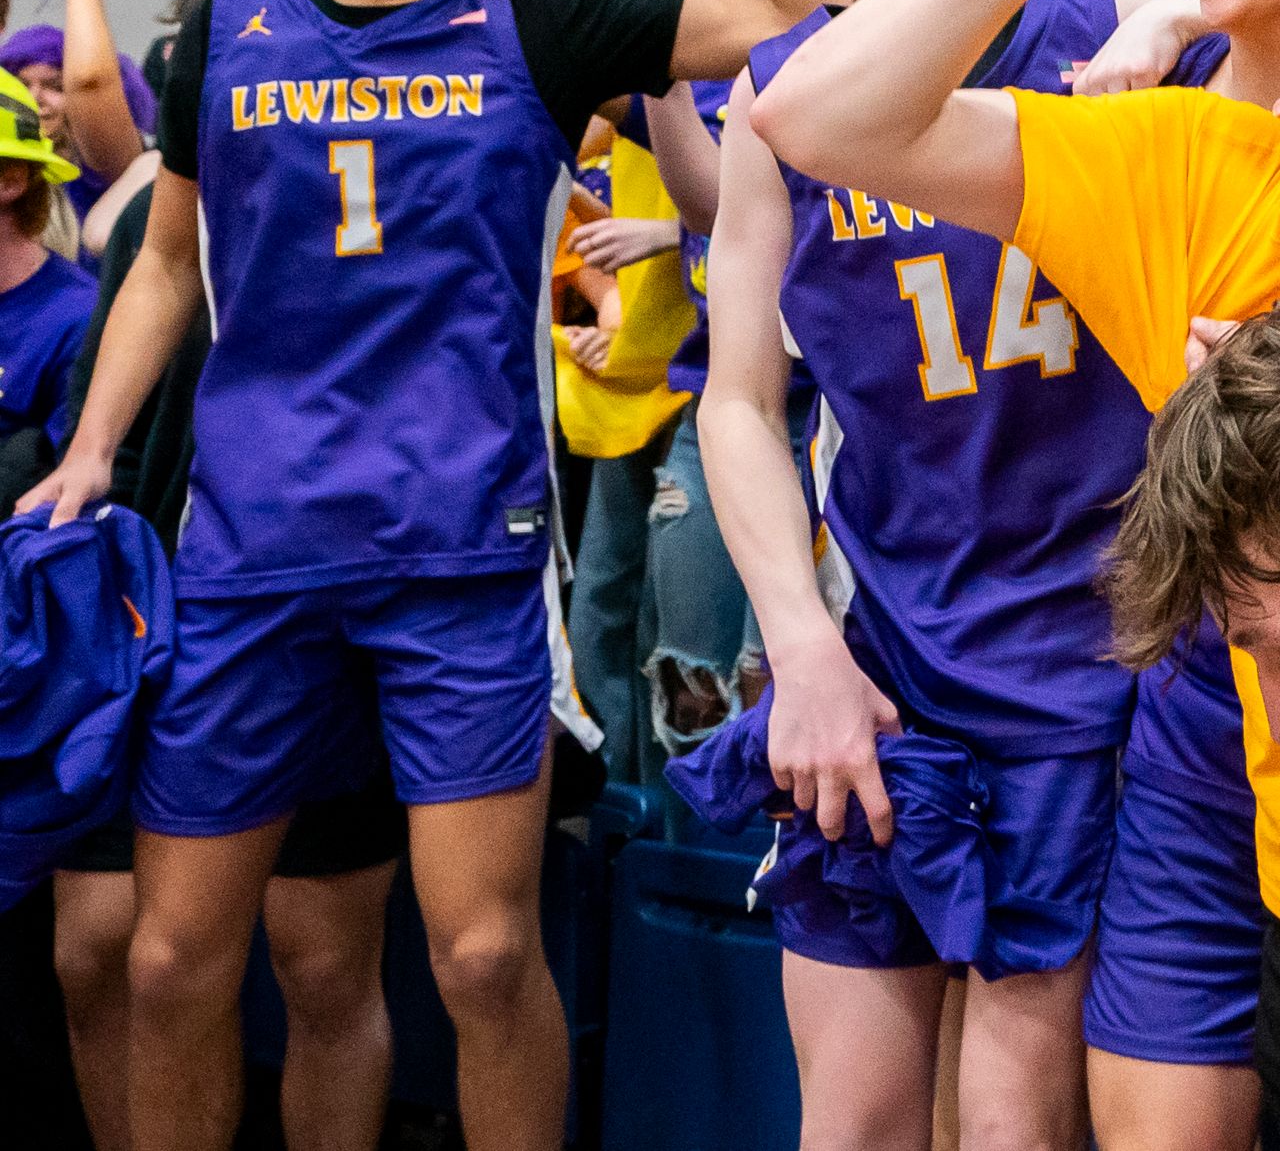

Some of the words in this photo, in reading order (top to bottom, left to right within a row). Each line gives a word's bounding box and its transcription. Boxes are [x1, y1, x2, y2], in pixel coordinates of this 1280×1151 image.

[231, 74, 485, 132] LEWISTON
[328, 139, 384, 258] 1
[894, 251, 1080, 402] 14
